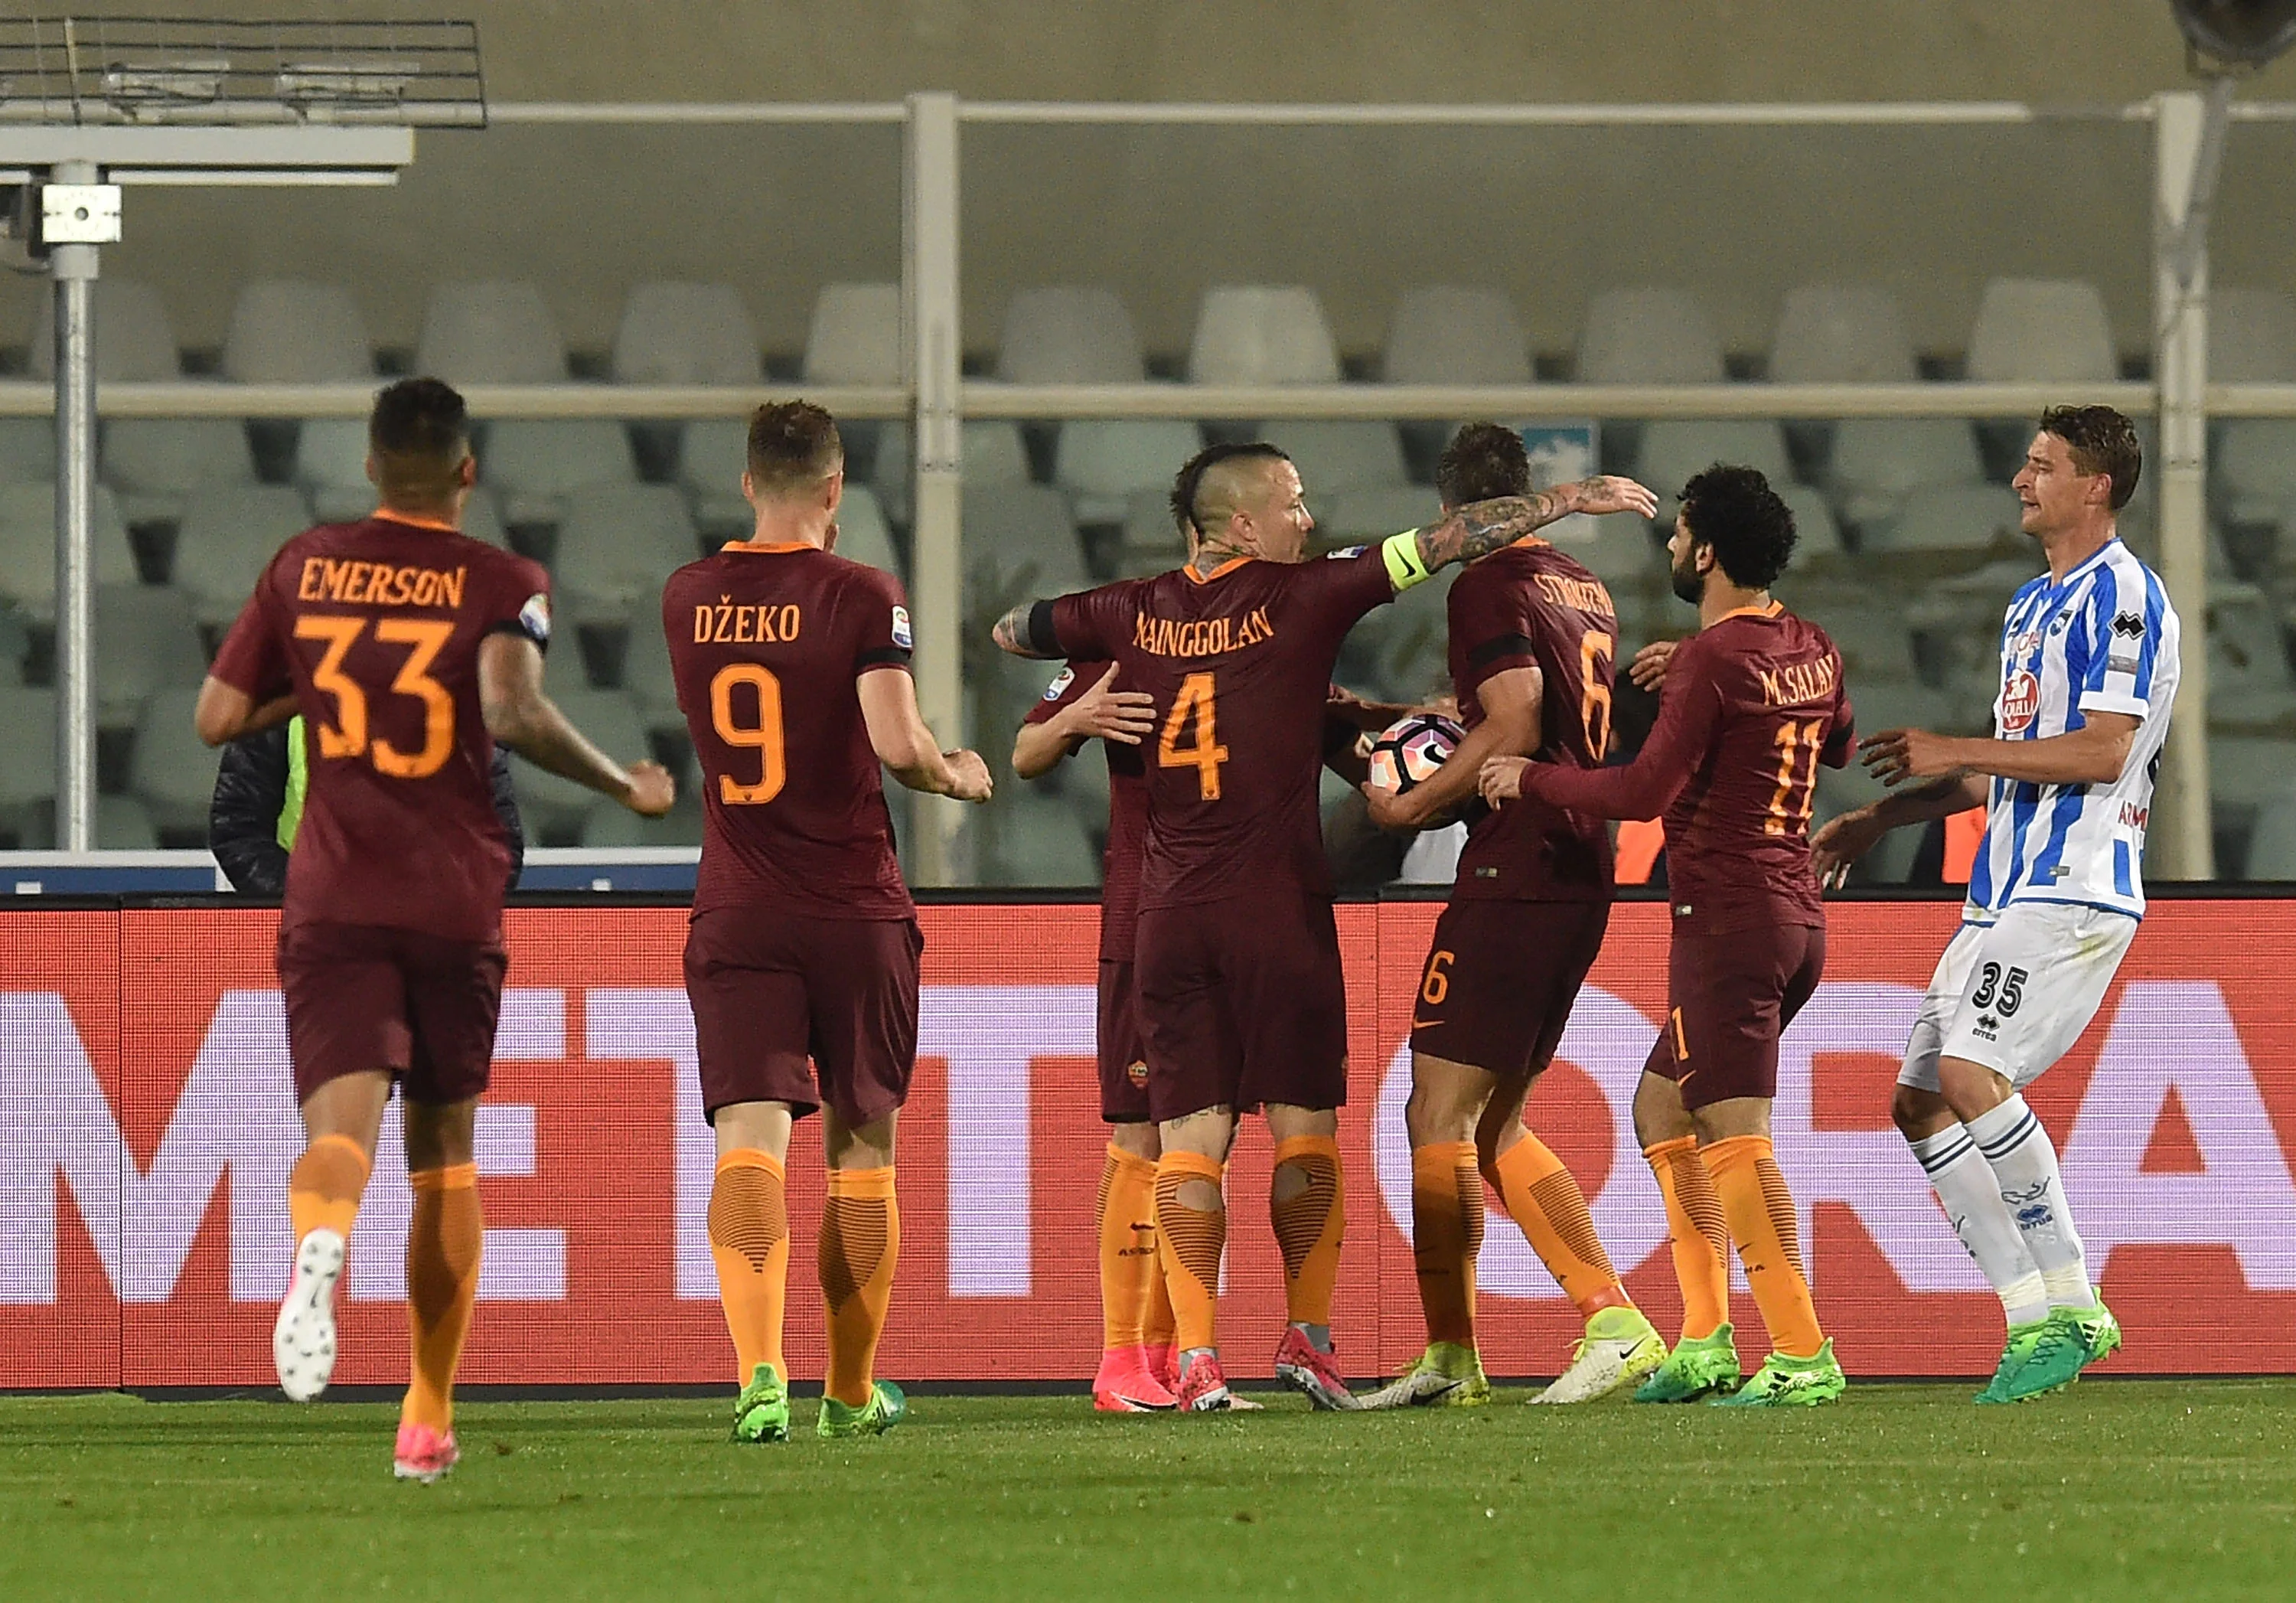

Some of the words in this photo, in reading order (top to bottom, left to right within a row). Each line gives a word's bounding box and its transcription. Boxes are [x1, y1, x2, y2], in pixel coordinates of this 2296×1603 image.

[298, 557, 465, 609] EMERSON
[693, 594, 801, 643] DŽEKO
[1133, 606, 1274, 657] NAINGGOLAN
[294, 615, 455, 779] 33
[709, 663, 786, 805] 9
[1157, 672, 1228, 801] 4
[1580, 629, 1613, 762] 6
[1763, 718, 1824, 836] 11
[1421, 949, 1455, 1004] 6
[1972, 961, 2029, 1018] 35
